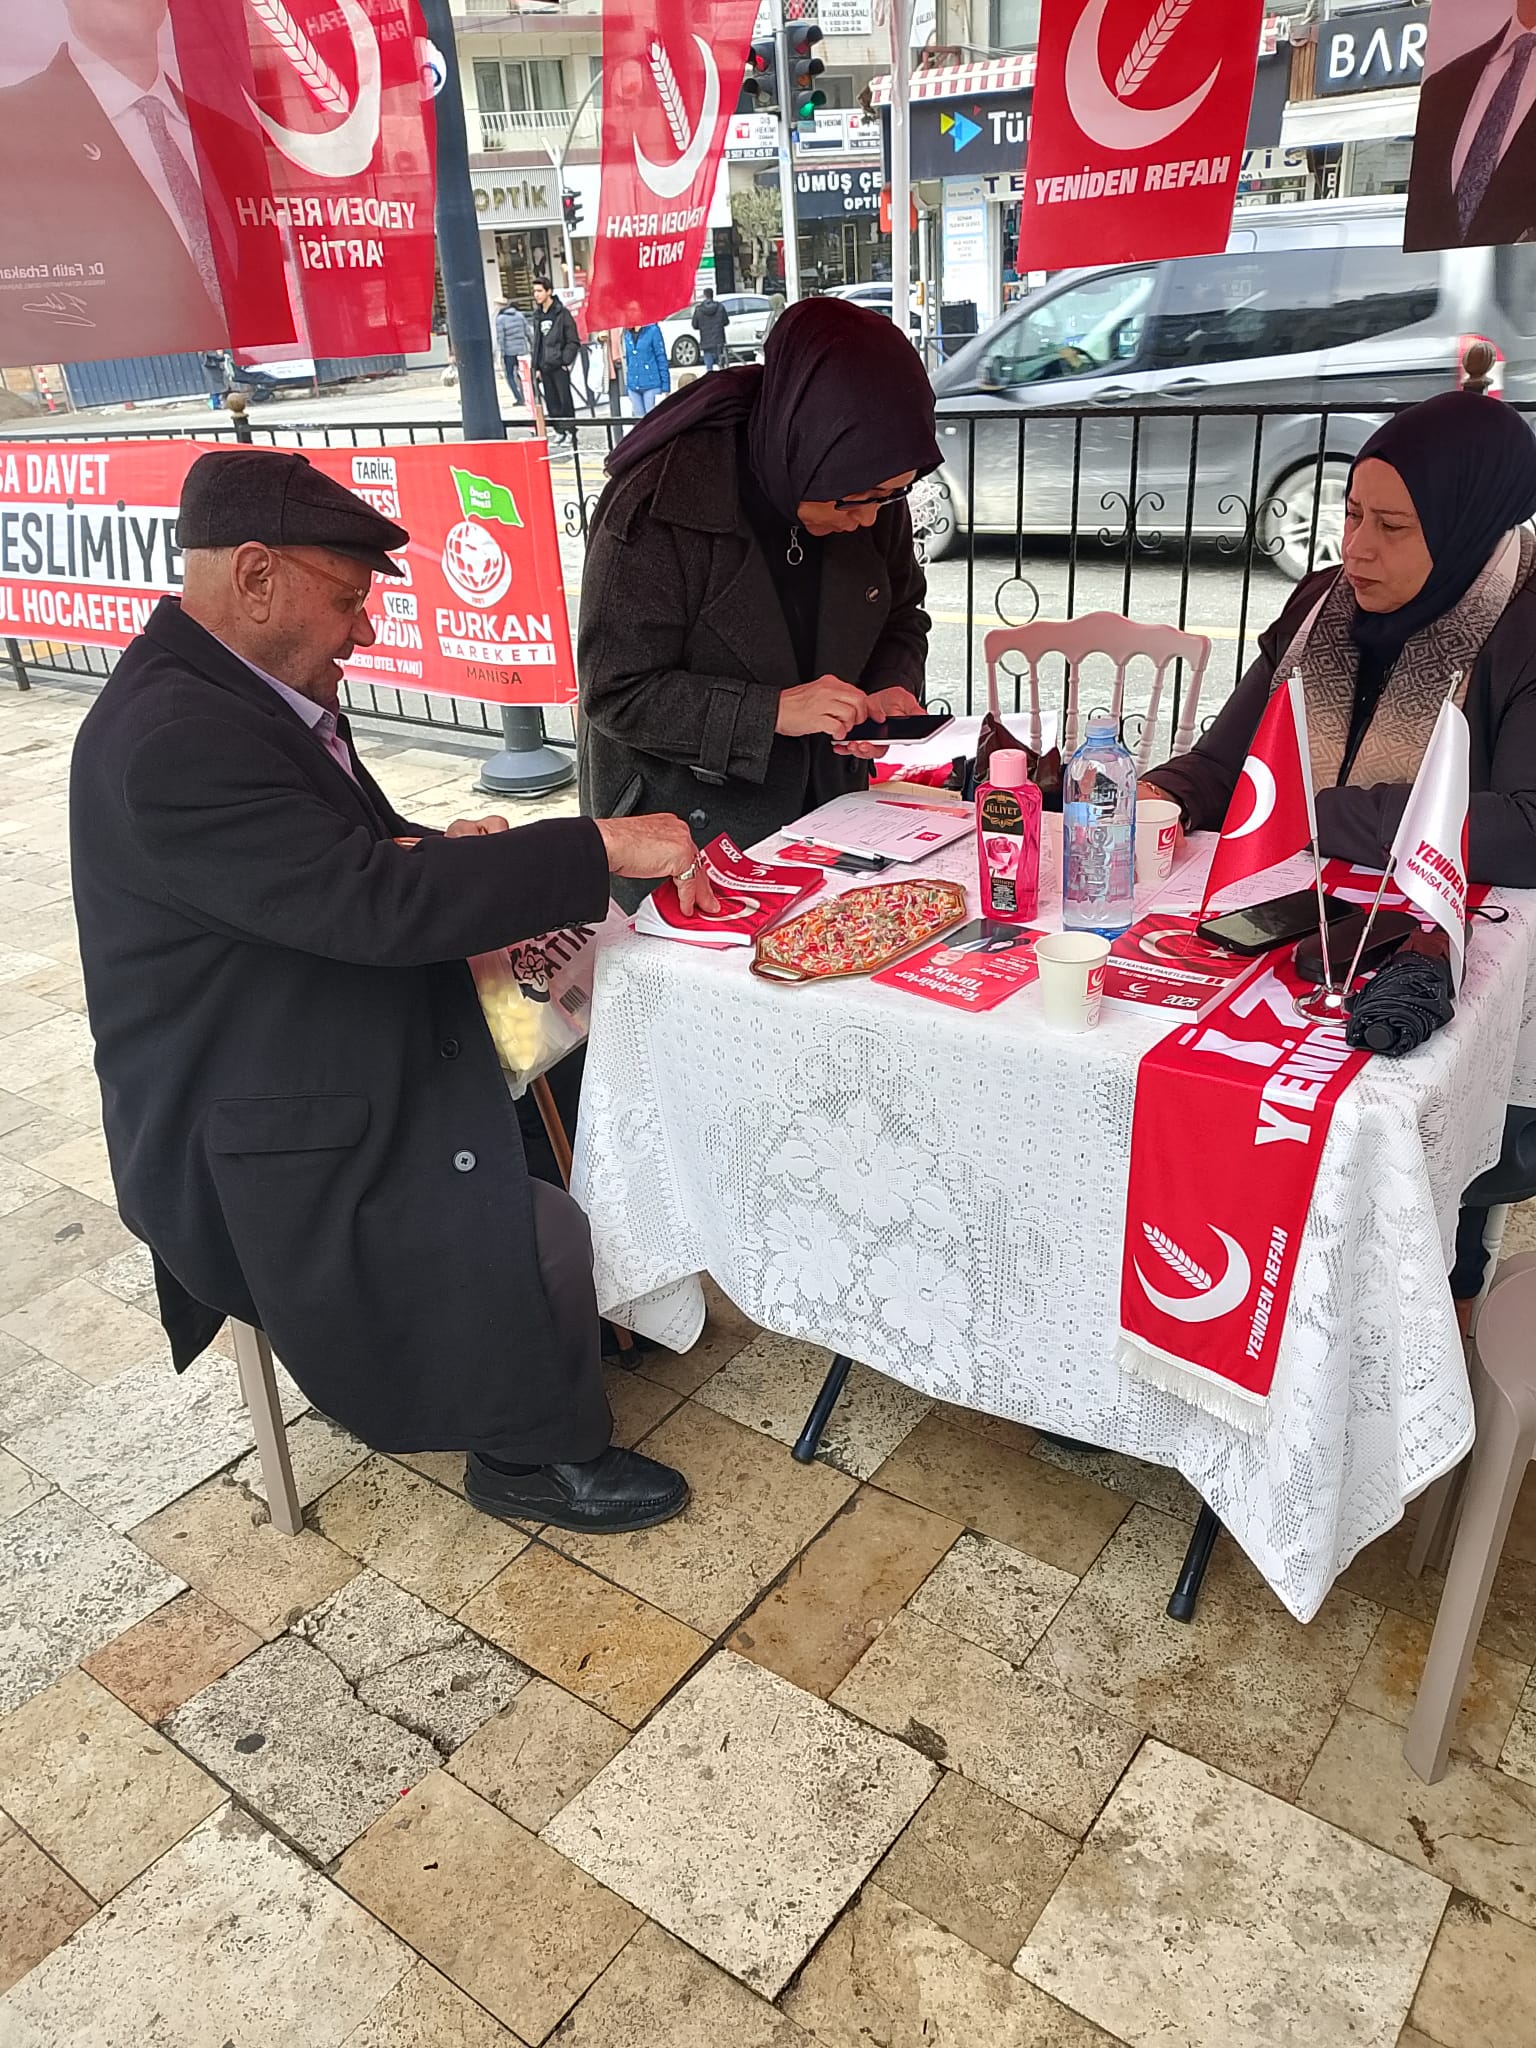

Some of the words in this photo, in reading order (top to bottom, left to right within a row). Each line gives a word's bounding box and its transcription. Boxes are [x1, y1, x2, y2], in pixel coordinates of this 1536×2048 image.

[473, 180, 548, 212] OPTİK
[793, 171, 852, 194] ÜMÜŞ
[1036, 166, 1141, 206] YENİDEN
[1146, 156, 1232, 193] REFAH
[27, 454, 110, 496] DAVET
[355, 457, 394, 481] TARİH:
[22, 587, 177, 636] HOCAEFEN
[387, 596, 415, 616] YER:
[370, 614, 424, 650] ÜĞÜN
[435, 607, 553, 642] FURKAN
[442, 641, 553, 662] HAREKETİ
[466, 665, 523, 685] MANİSA
[985, 803, 1019, 817] JÜLİYET
[1406, 858, 1442, 892] MANİSA
[1441, 886, 1451, 901] İL
[1415, 839, 1466, 898] YENİDEN
[1161, 994, 1201, 1008] 2025
[1254, 1025, 1350, 1147] YENİD
[1244, 1285, 1275, 1361] YENİDEN
[1263, 1225, 1289, 1288] REFAH
